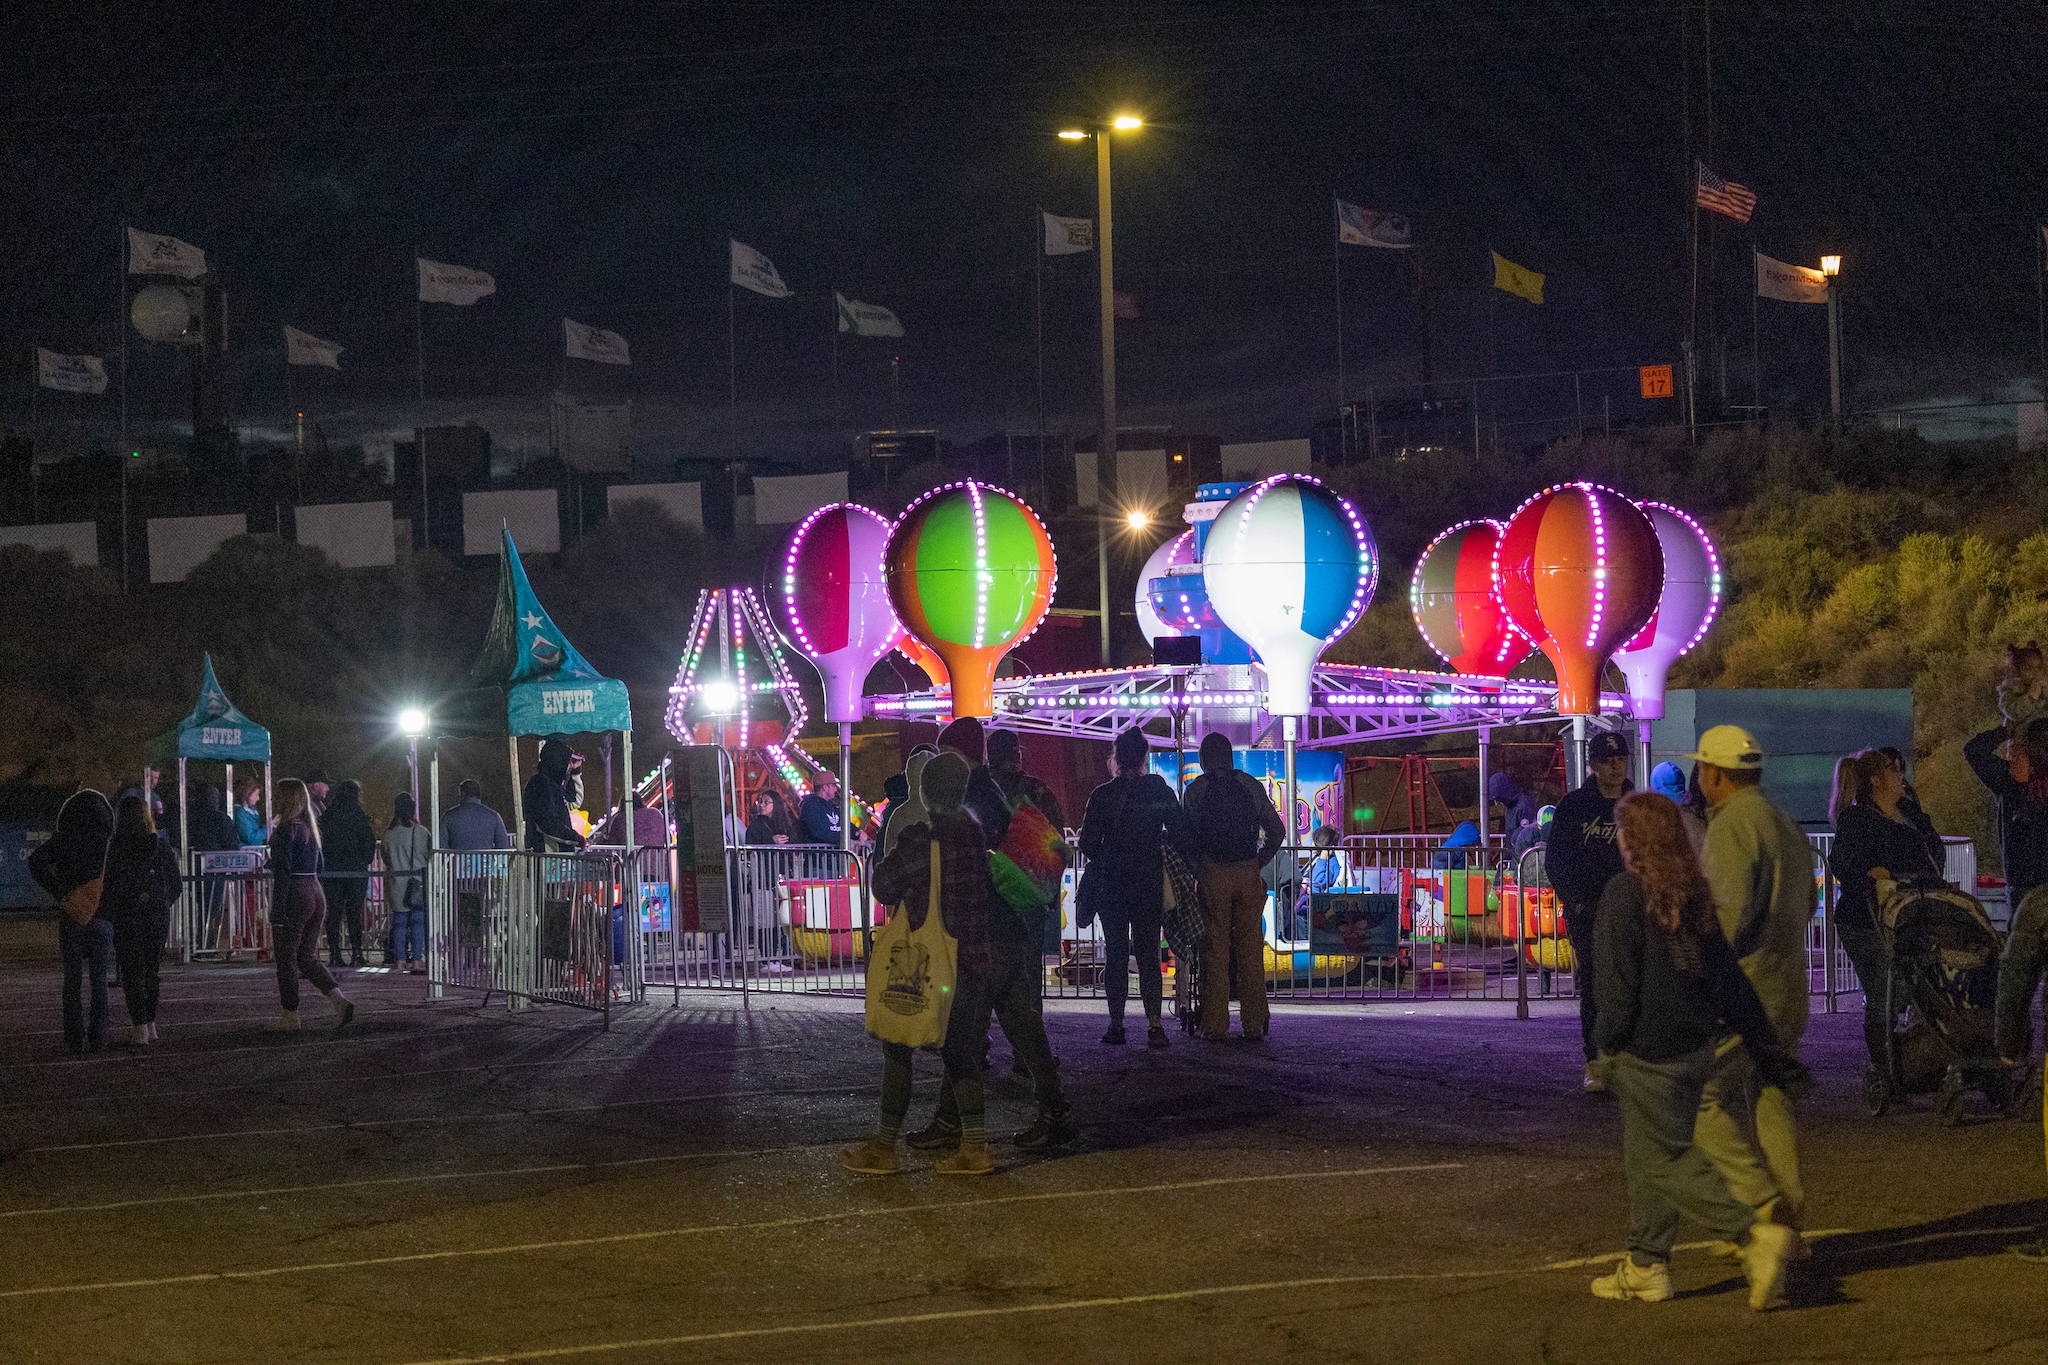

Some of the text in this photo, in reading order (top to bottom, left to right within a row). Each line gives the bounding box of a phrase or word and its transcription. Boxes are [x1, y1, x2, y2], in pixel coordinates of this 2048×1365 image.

[1643, 369, 1669, 378] GATE
[1648, 380, 1665, 393] 17
[541, 689, 596, 714] ENTER
[202, 726, 242, 745] ENTER
[214, 855, 248, 866] ENTER
[697, 864, 724, 875] NOTICE
[1315, 900, 1331, 913] UP
[1332, 900, 1349, 913] UP
